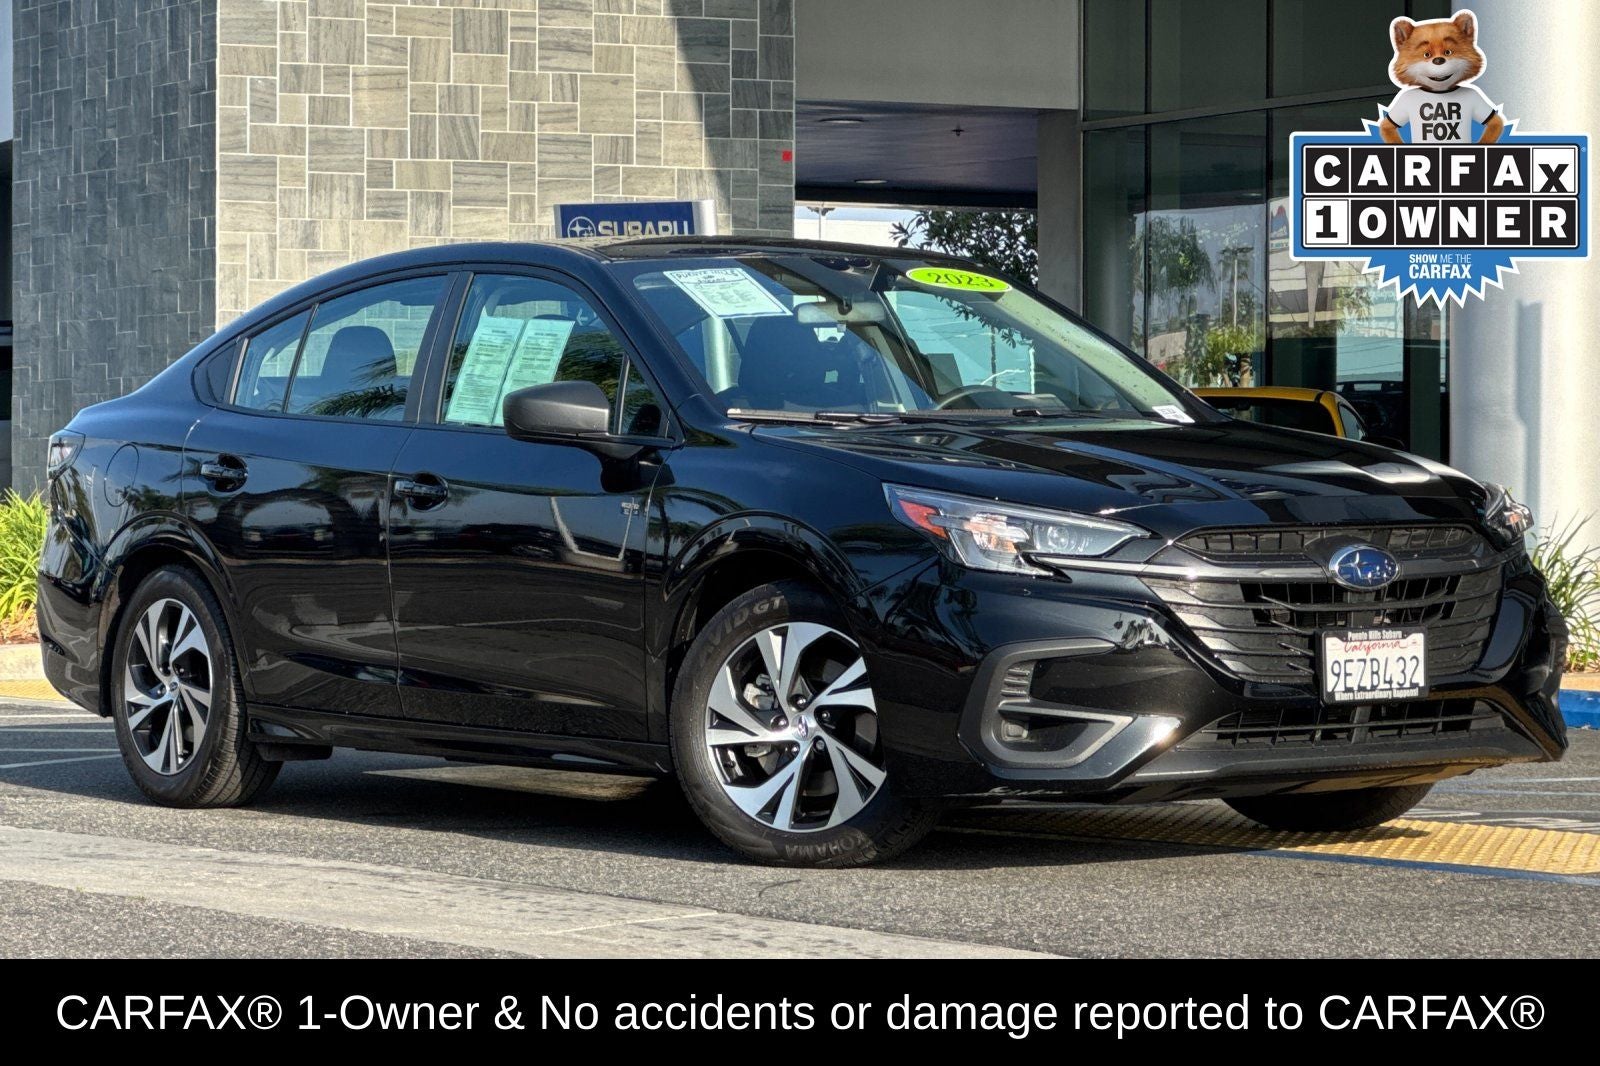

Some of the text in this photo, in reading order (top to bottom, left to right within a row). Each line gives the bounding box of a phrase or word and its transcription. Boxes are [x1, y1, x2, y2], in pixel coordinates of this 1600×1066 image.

[927, 272, 995, 288] 2023
[1344, 640, 1407, 656] California
[1330, 655, 1420, 692] 9EZB432
